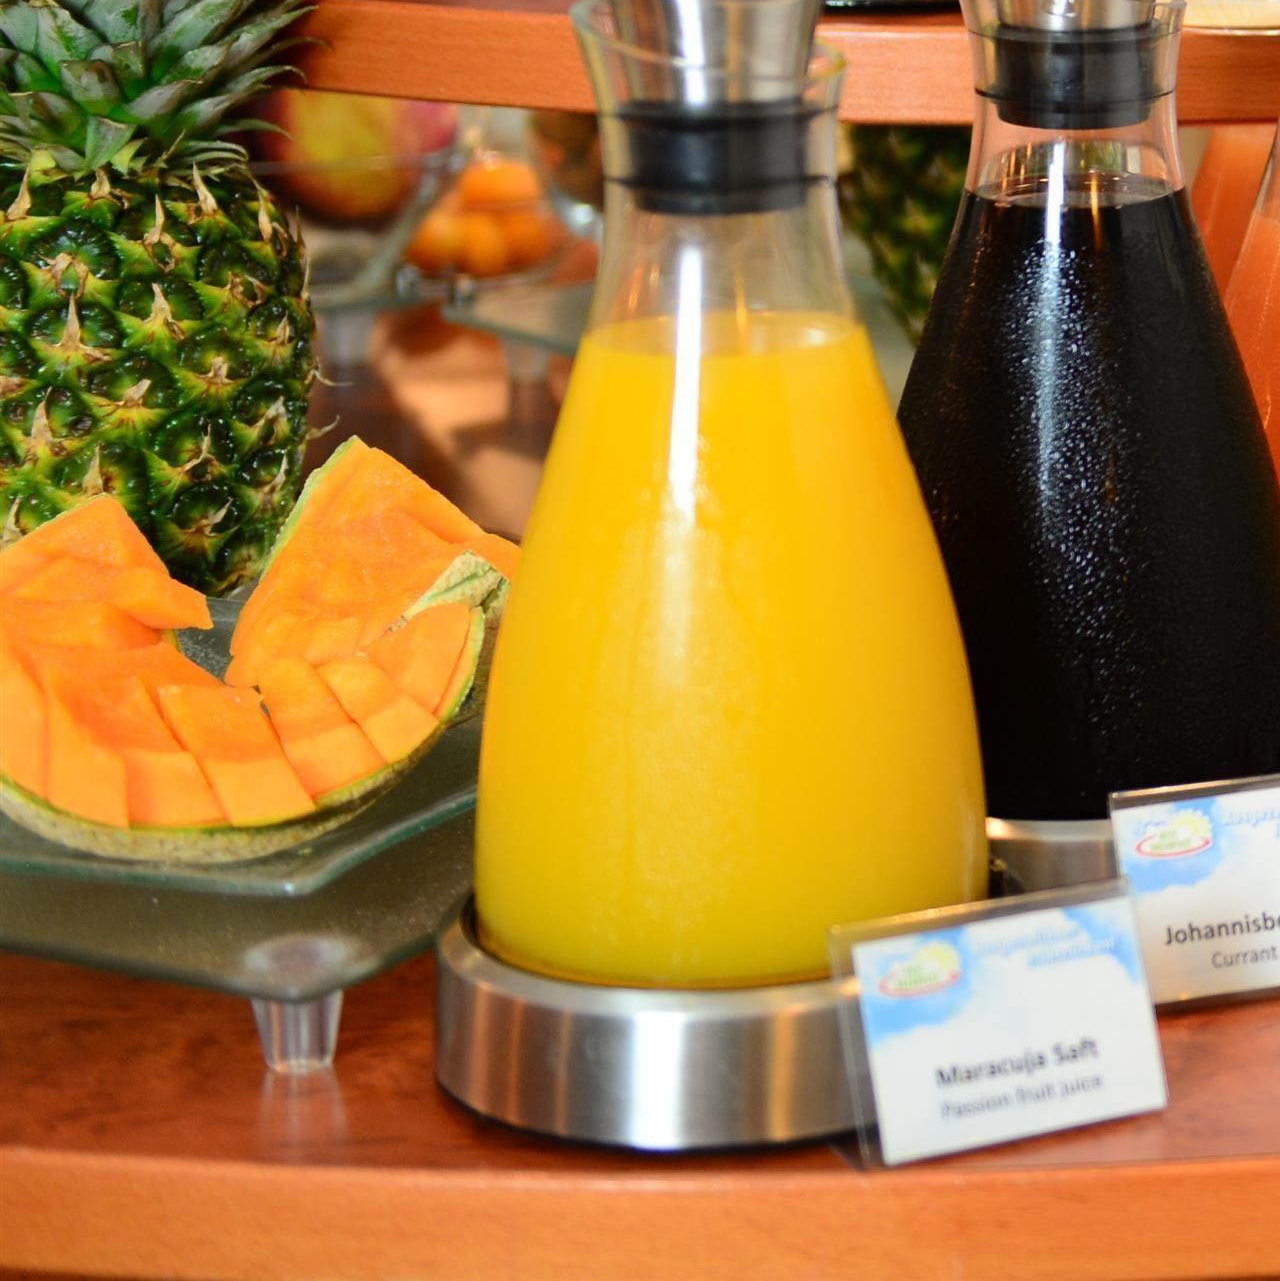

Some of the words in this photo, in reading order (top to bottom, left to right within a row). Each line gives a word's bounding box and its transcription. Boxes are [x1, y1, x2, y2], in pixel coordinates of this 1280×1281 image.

[1210, 944, 1279, 970] Currant
[934, 1045, 1047, 1088] Maracuja
[1052, 1036, 1100, 1064] Saft
